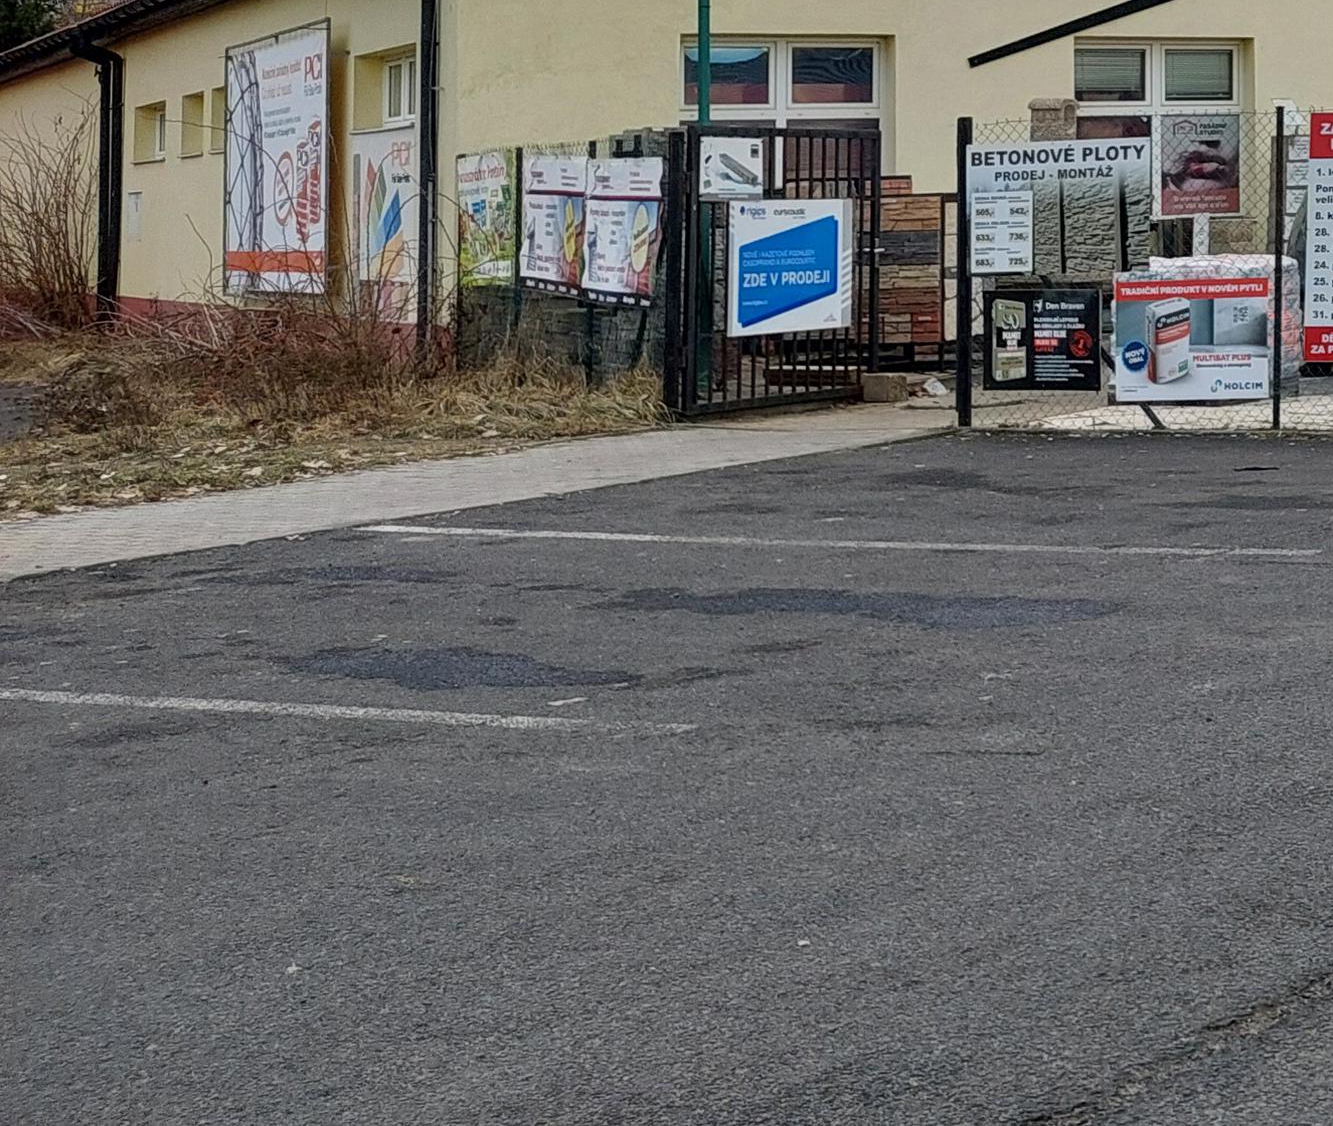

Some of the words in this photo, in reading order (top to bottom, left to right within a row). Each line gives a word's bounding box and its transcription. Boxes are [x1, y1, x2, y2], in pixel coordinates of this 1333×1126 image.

[971, 145, 1075, 167] BETONOVÉ
[1082, 144, 1146, 162] PLOTY
[994, 169, 1046, 183] PRODEJ
[1057, 166, 1114, 180] MONTÁŽ
[1316, 168, 1326, 176] 1.
[1314, 228, 1330, 236] 28.
[1313, 244, 1330, 253] 28.
[1313, 261, 1329, 269] 24.
[743, 272, 767, 288] ZDE
[770, 272, 779, 286] V
[781, 269, 831, 286] PRODEJI
[1313, 277, 1329, 286] 25.
[1120, 286, 1160, 296] TRADIČNÍ
[1160, 286, 1201, 295] PRODUKT
[1206, 284, 1239, 293] NOVÉM
[1239, 283, 1263, 292] PYTLI
[1312, 294, 1328, 302] 26.
[1045, 302, 1059, 310] Den
[1312, 310, 1328, 319] 31.
[1310, 345, 1326, 354] ZA
[1224, 381, 1263, 390] HOLCIM
